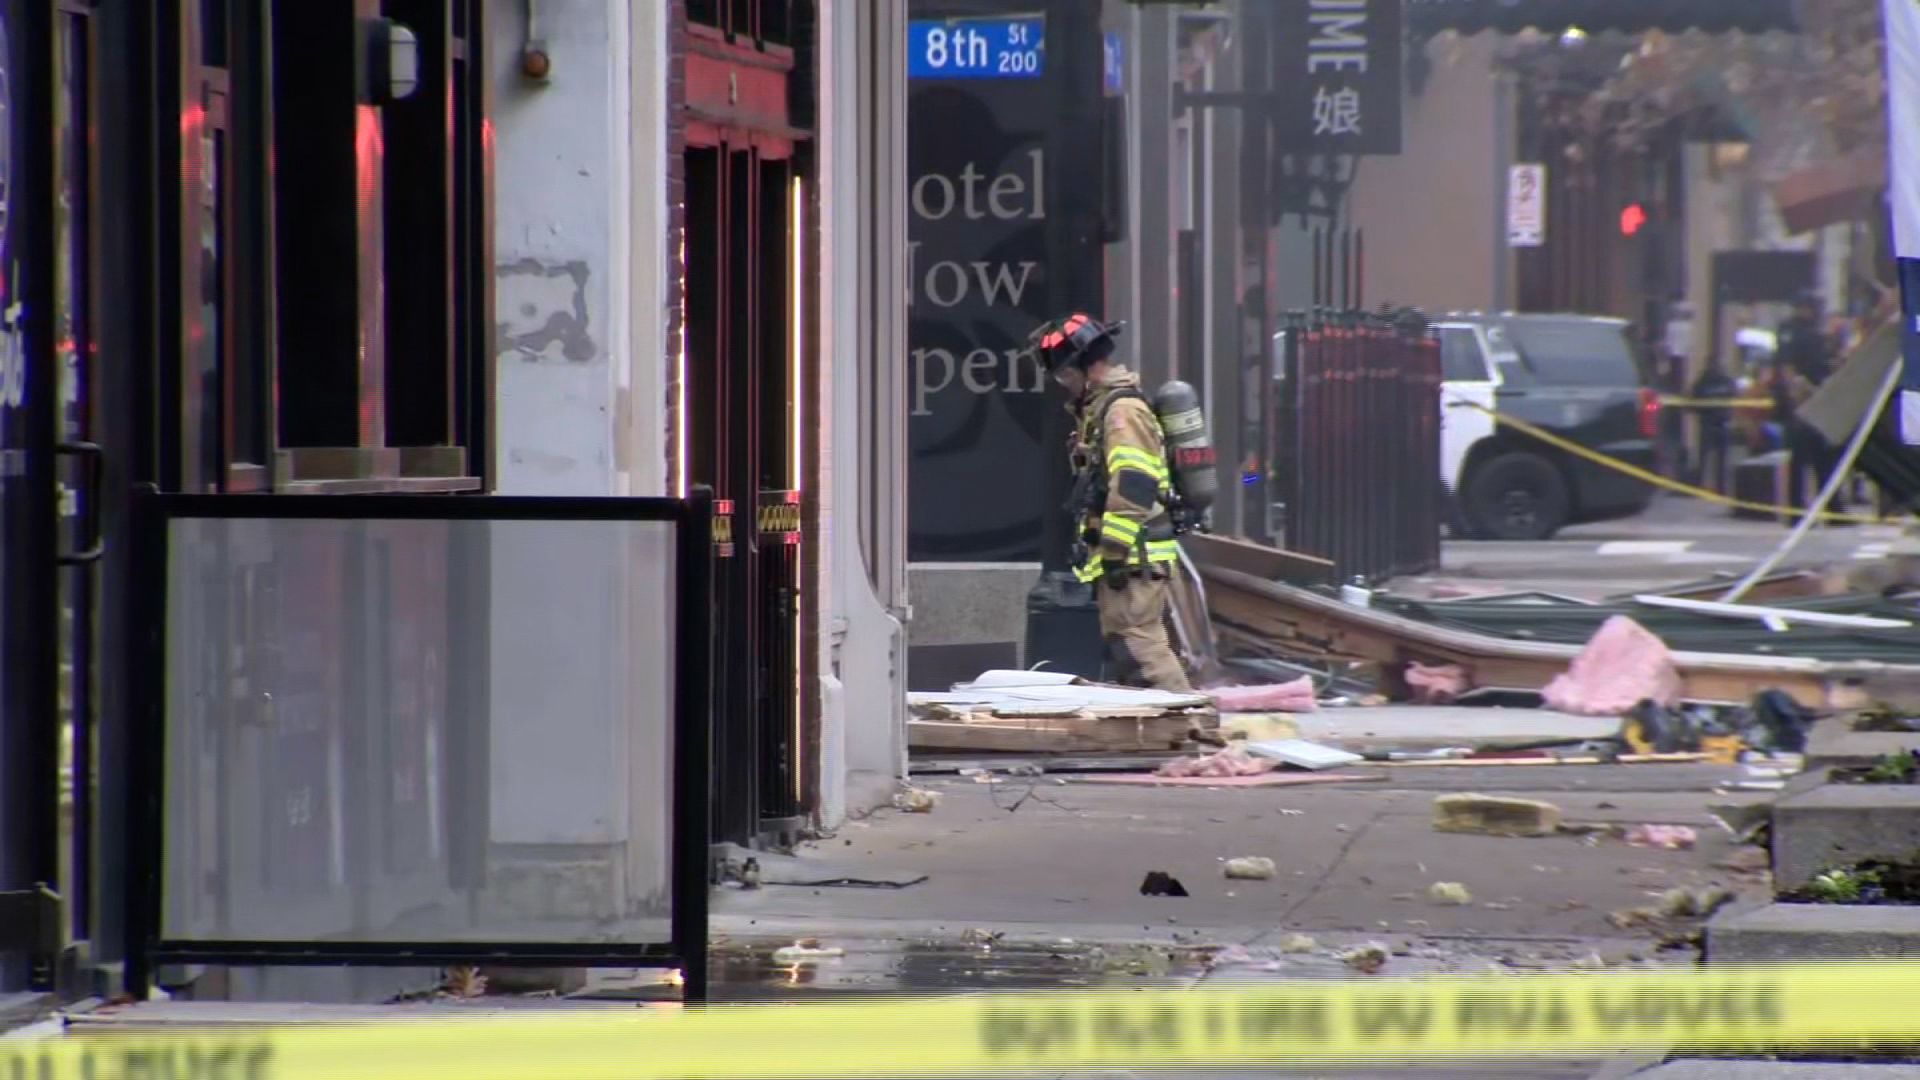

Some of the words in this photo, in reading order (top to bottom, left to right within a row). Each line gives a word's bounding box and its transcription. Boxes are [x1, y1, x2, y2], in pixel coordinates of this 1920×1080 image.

[926, 27, 988, 67] 8th
[1008, 23, 1028, 46] St
[998, 49, 1037, 73] 200
[1312, 86, 1361, 136] 娘
[912, 148, 1046, 220] otel
[911, 346, 1046, 416] pen
